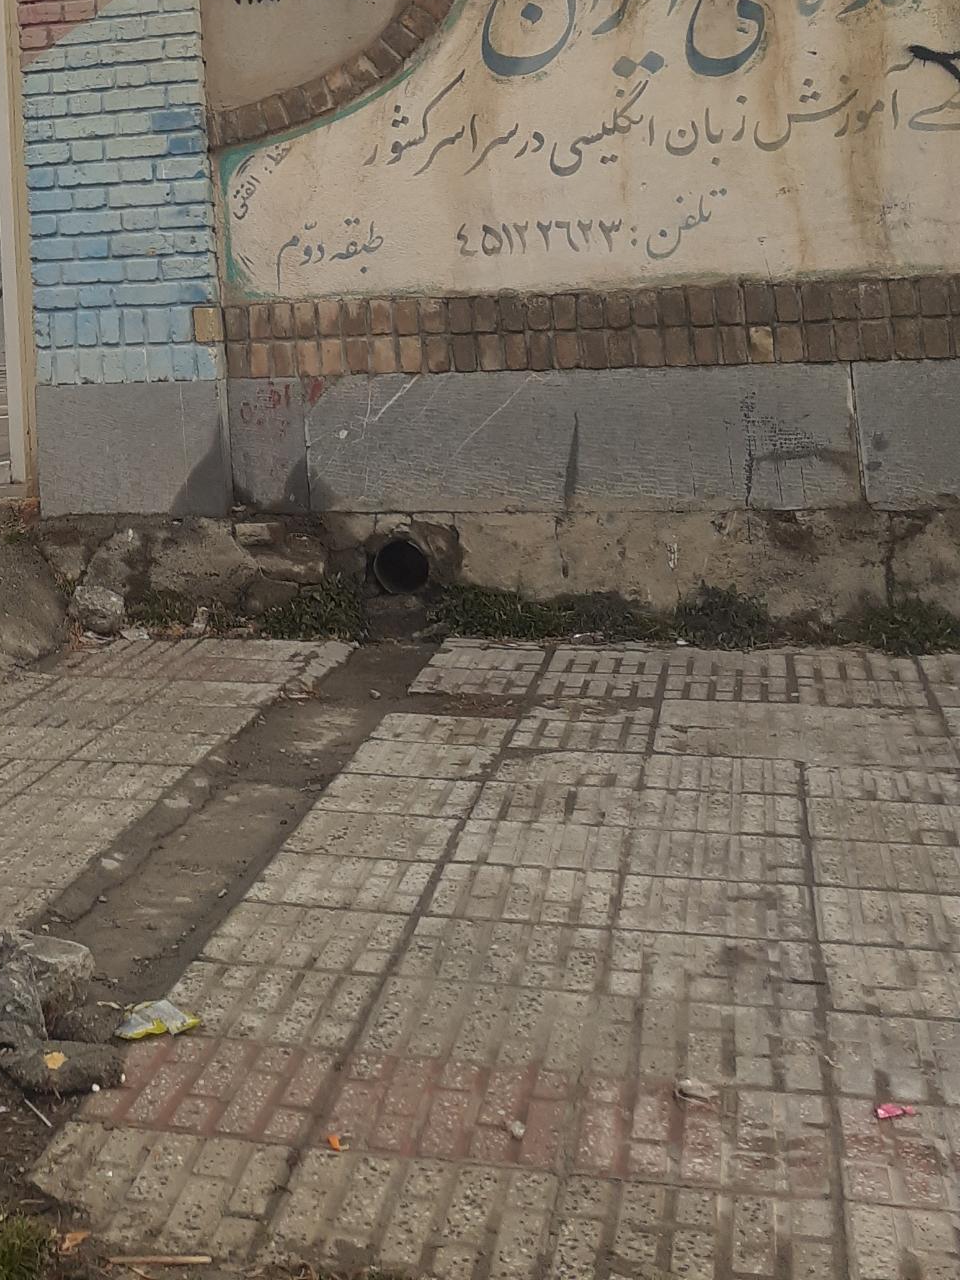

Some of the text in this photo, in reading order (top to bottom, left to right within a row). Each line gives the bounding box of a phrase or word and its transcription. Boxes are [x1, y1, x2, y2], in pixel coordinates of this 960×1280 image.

[362, 68, 466, 167] کشور
[413, 113, 520, 177] سراسر
[514, 131, 546, 159] در
[550, 79, 655, 177] انگلیسی
[664, 94, 748, 167] زبان
[330, 217, 385, 275] طبقه
